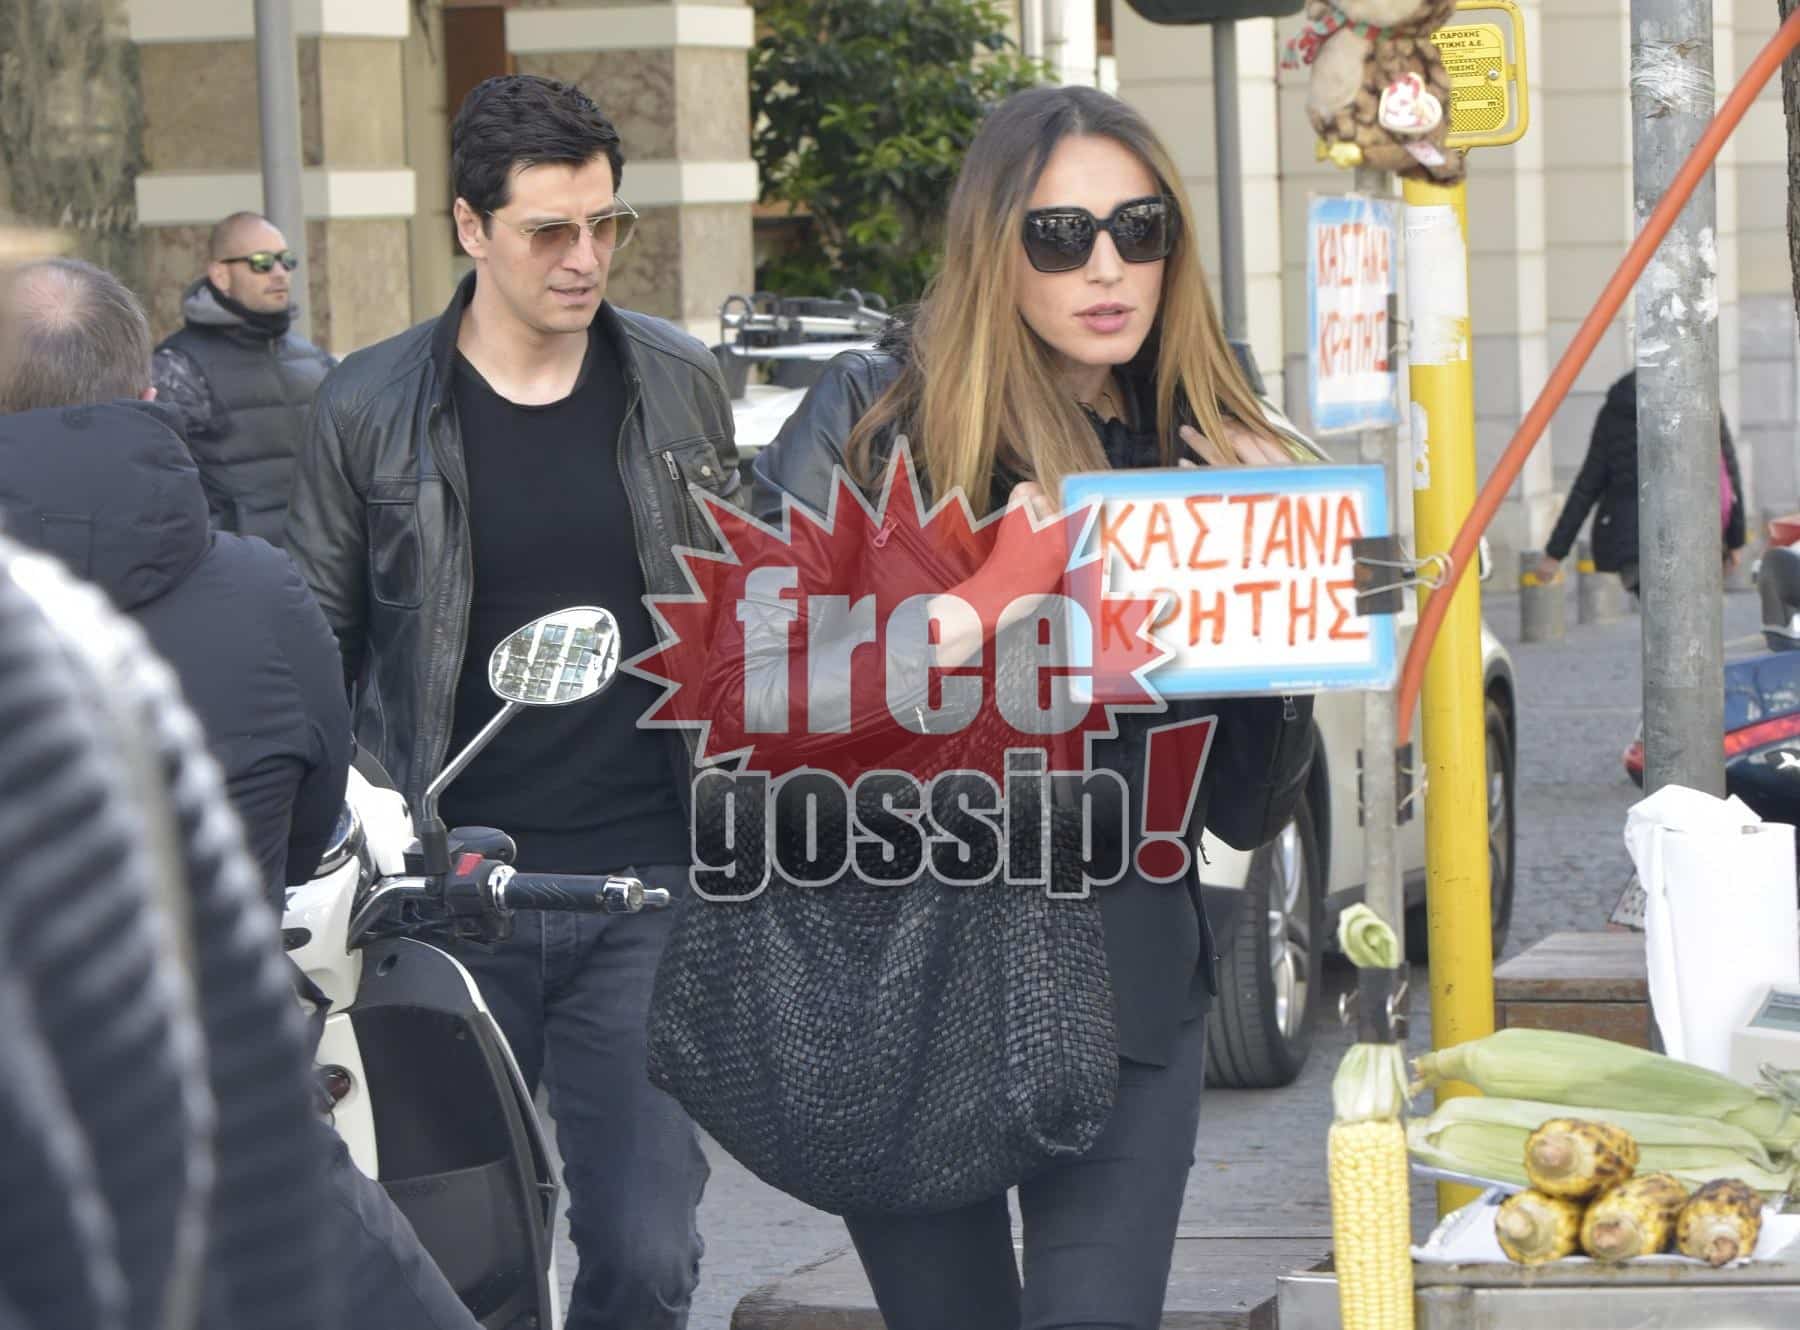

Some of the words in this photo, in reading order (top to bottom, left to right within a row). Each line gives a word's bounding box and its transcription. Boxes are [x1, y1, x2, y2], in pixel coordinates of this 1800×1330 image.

[1440, 31, 1480, 40] ΠΑΡΟΧΗΣ
[1100, 493, 1363, 573] ΚΑΣΤΑΝΑ
[1102, 576, 1368, 654] ΚΡΗΤΗΣ
